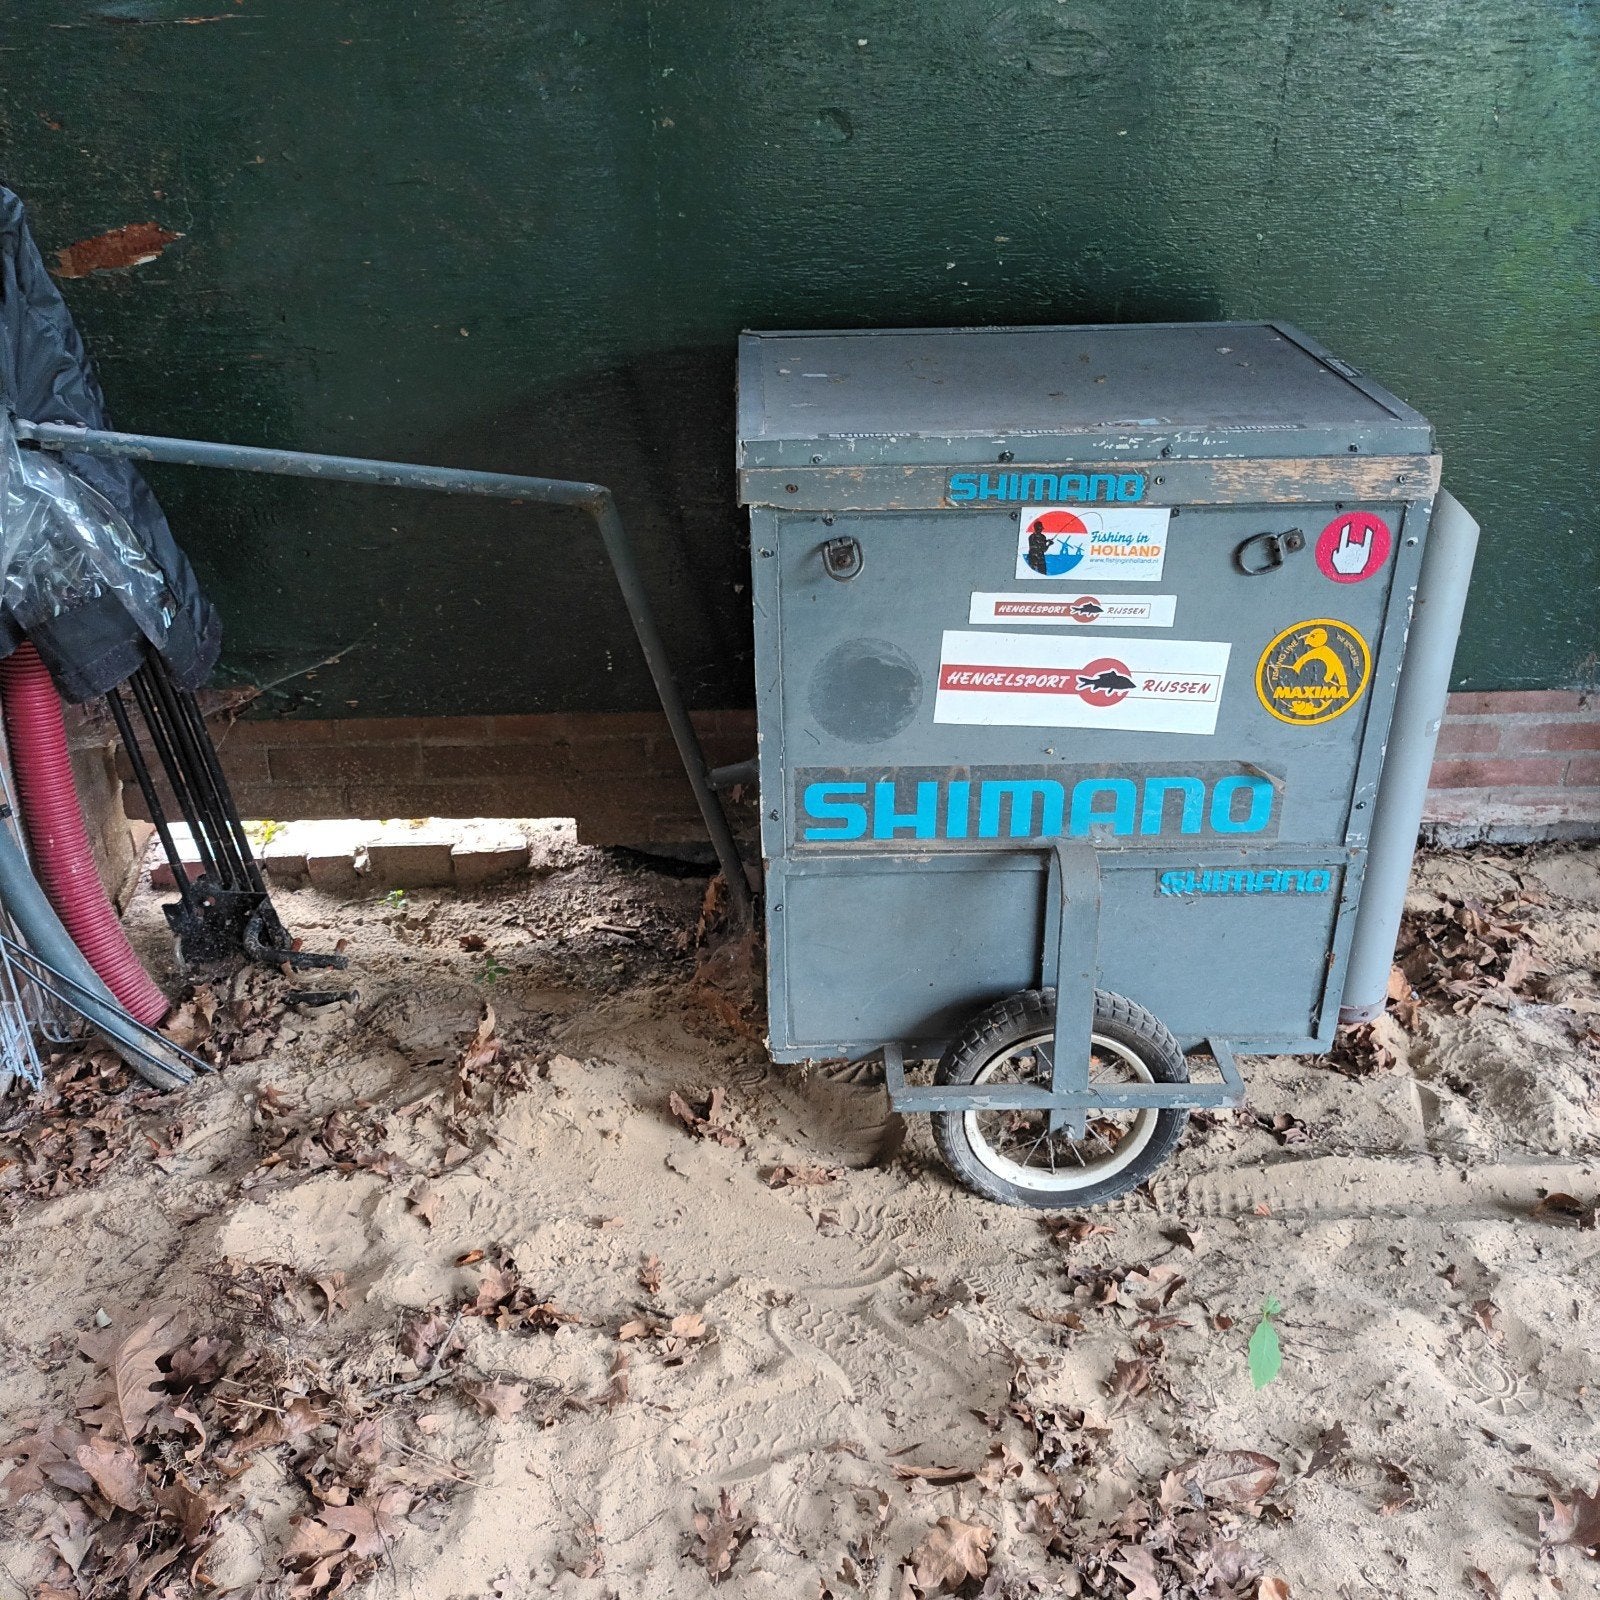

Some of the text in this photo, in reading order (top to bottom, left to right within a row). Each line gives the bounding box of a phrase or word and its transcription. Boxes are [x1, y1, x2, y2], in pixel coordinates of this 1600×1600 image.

[950, 473, 1145, 502] SHIMANO
[1090, 531, 1150, 544] Fishing in
[1090, 545, 1161, 557] HOLLAND
[998, 603, 1146, 615] HENGELSPORT RIJSSEN
[947, 671, 1212, 695] HENGELSPORT RIJSSEN
[1273, 686, 1350, 699] MAXIMA
[804, 775, 1274, 840] SHIMANO
[1160, 869, 1331, 895] SHIMANO
